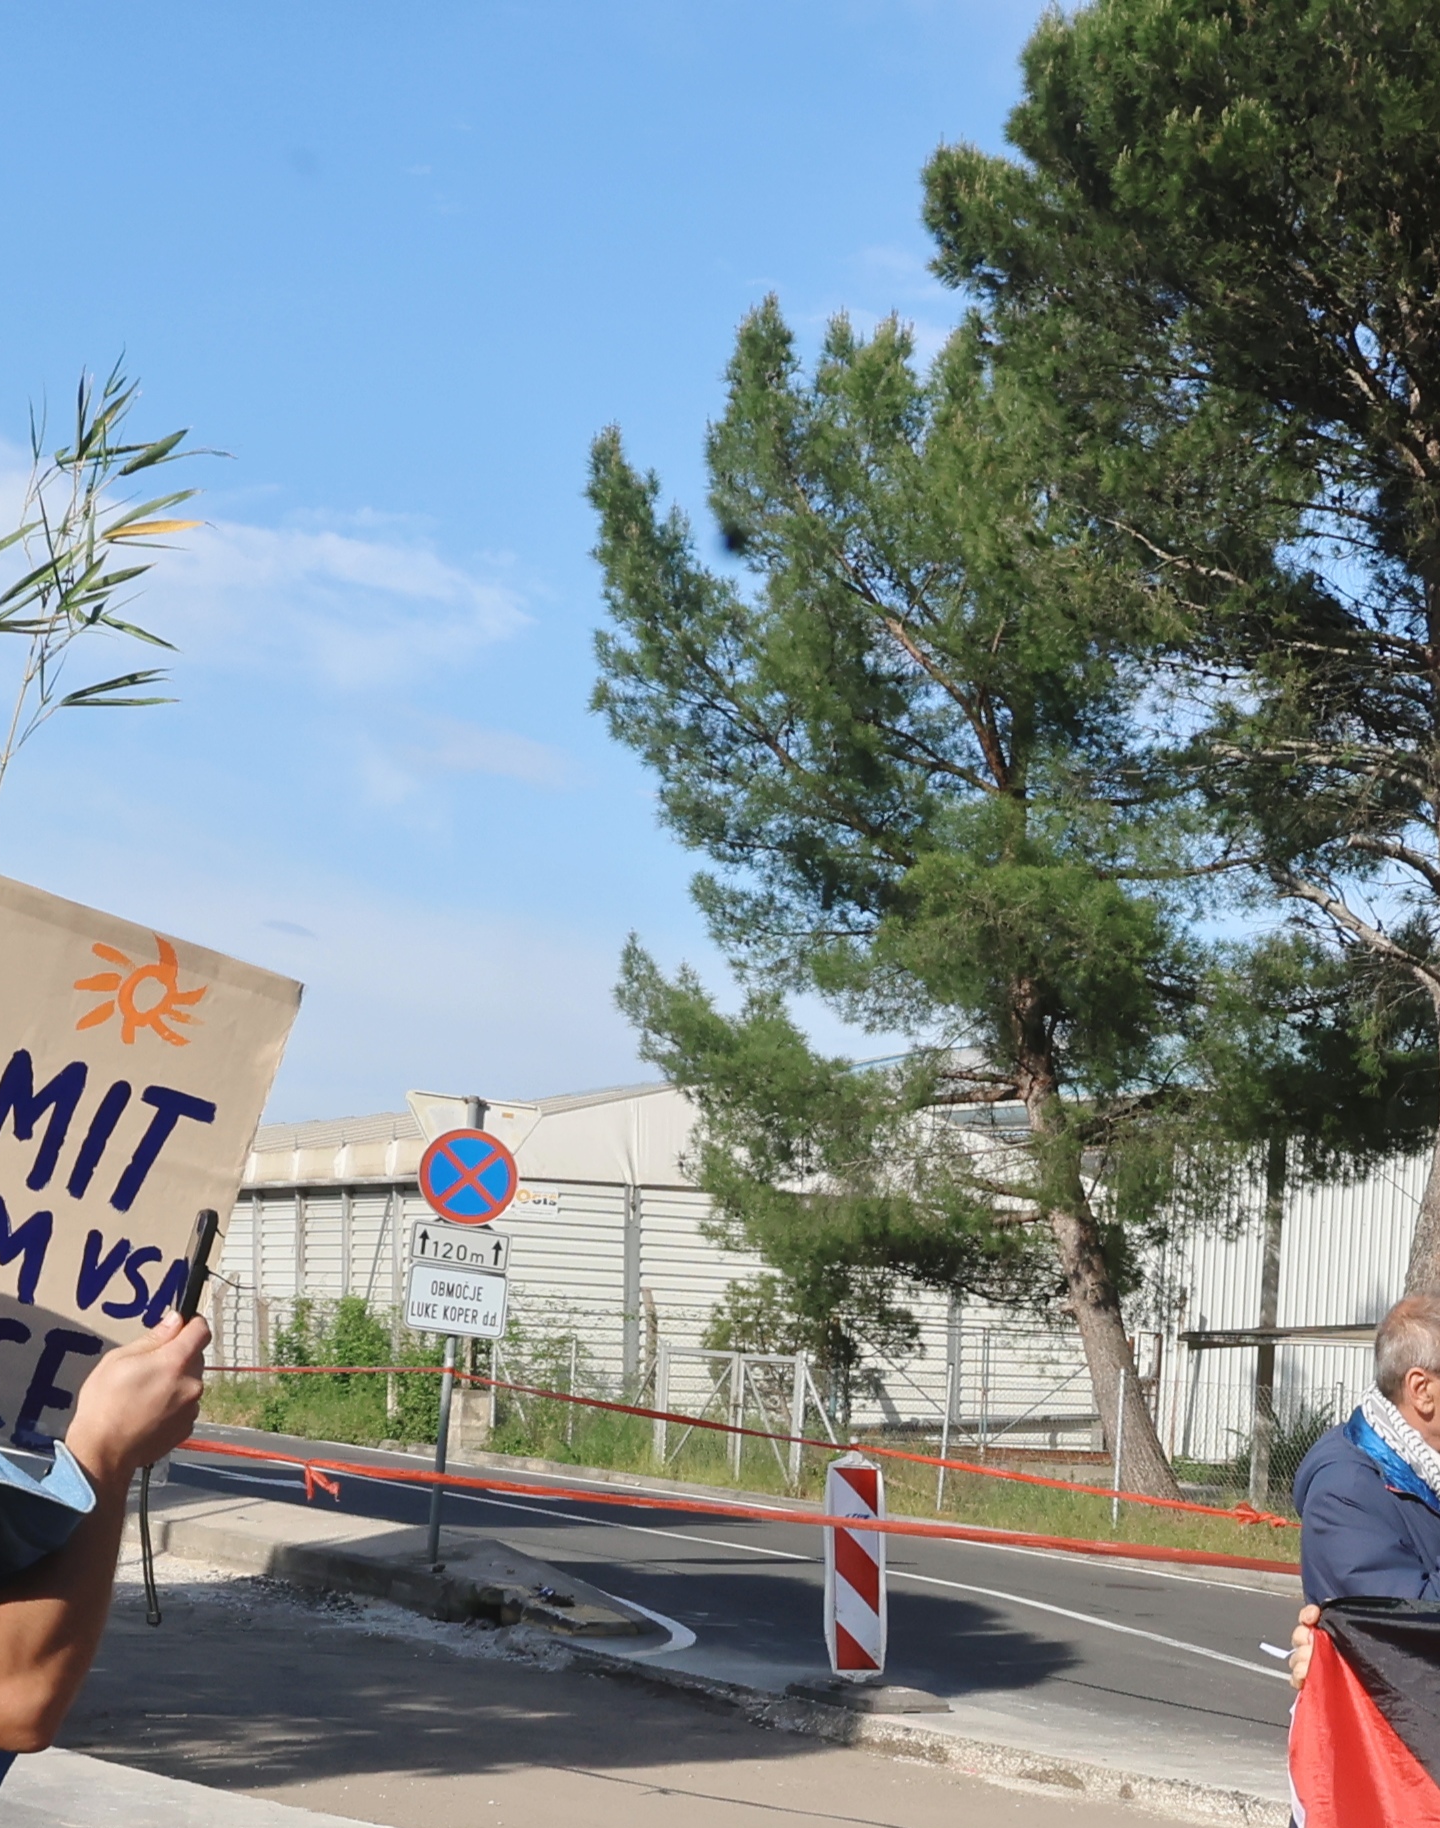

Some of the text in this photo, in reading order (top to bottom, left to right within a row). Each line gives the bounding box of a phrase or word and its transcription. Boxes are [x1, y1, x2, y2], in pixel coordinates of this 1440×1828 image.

[430, 1280, 484, 1302] OBMOČJE
[410, 1301, 438, 1320] LUKE
[443, 1305, 478, 1325] KOPER
